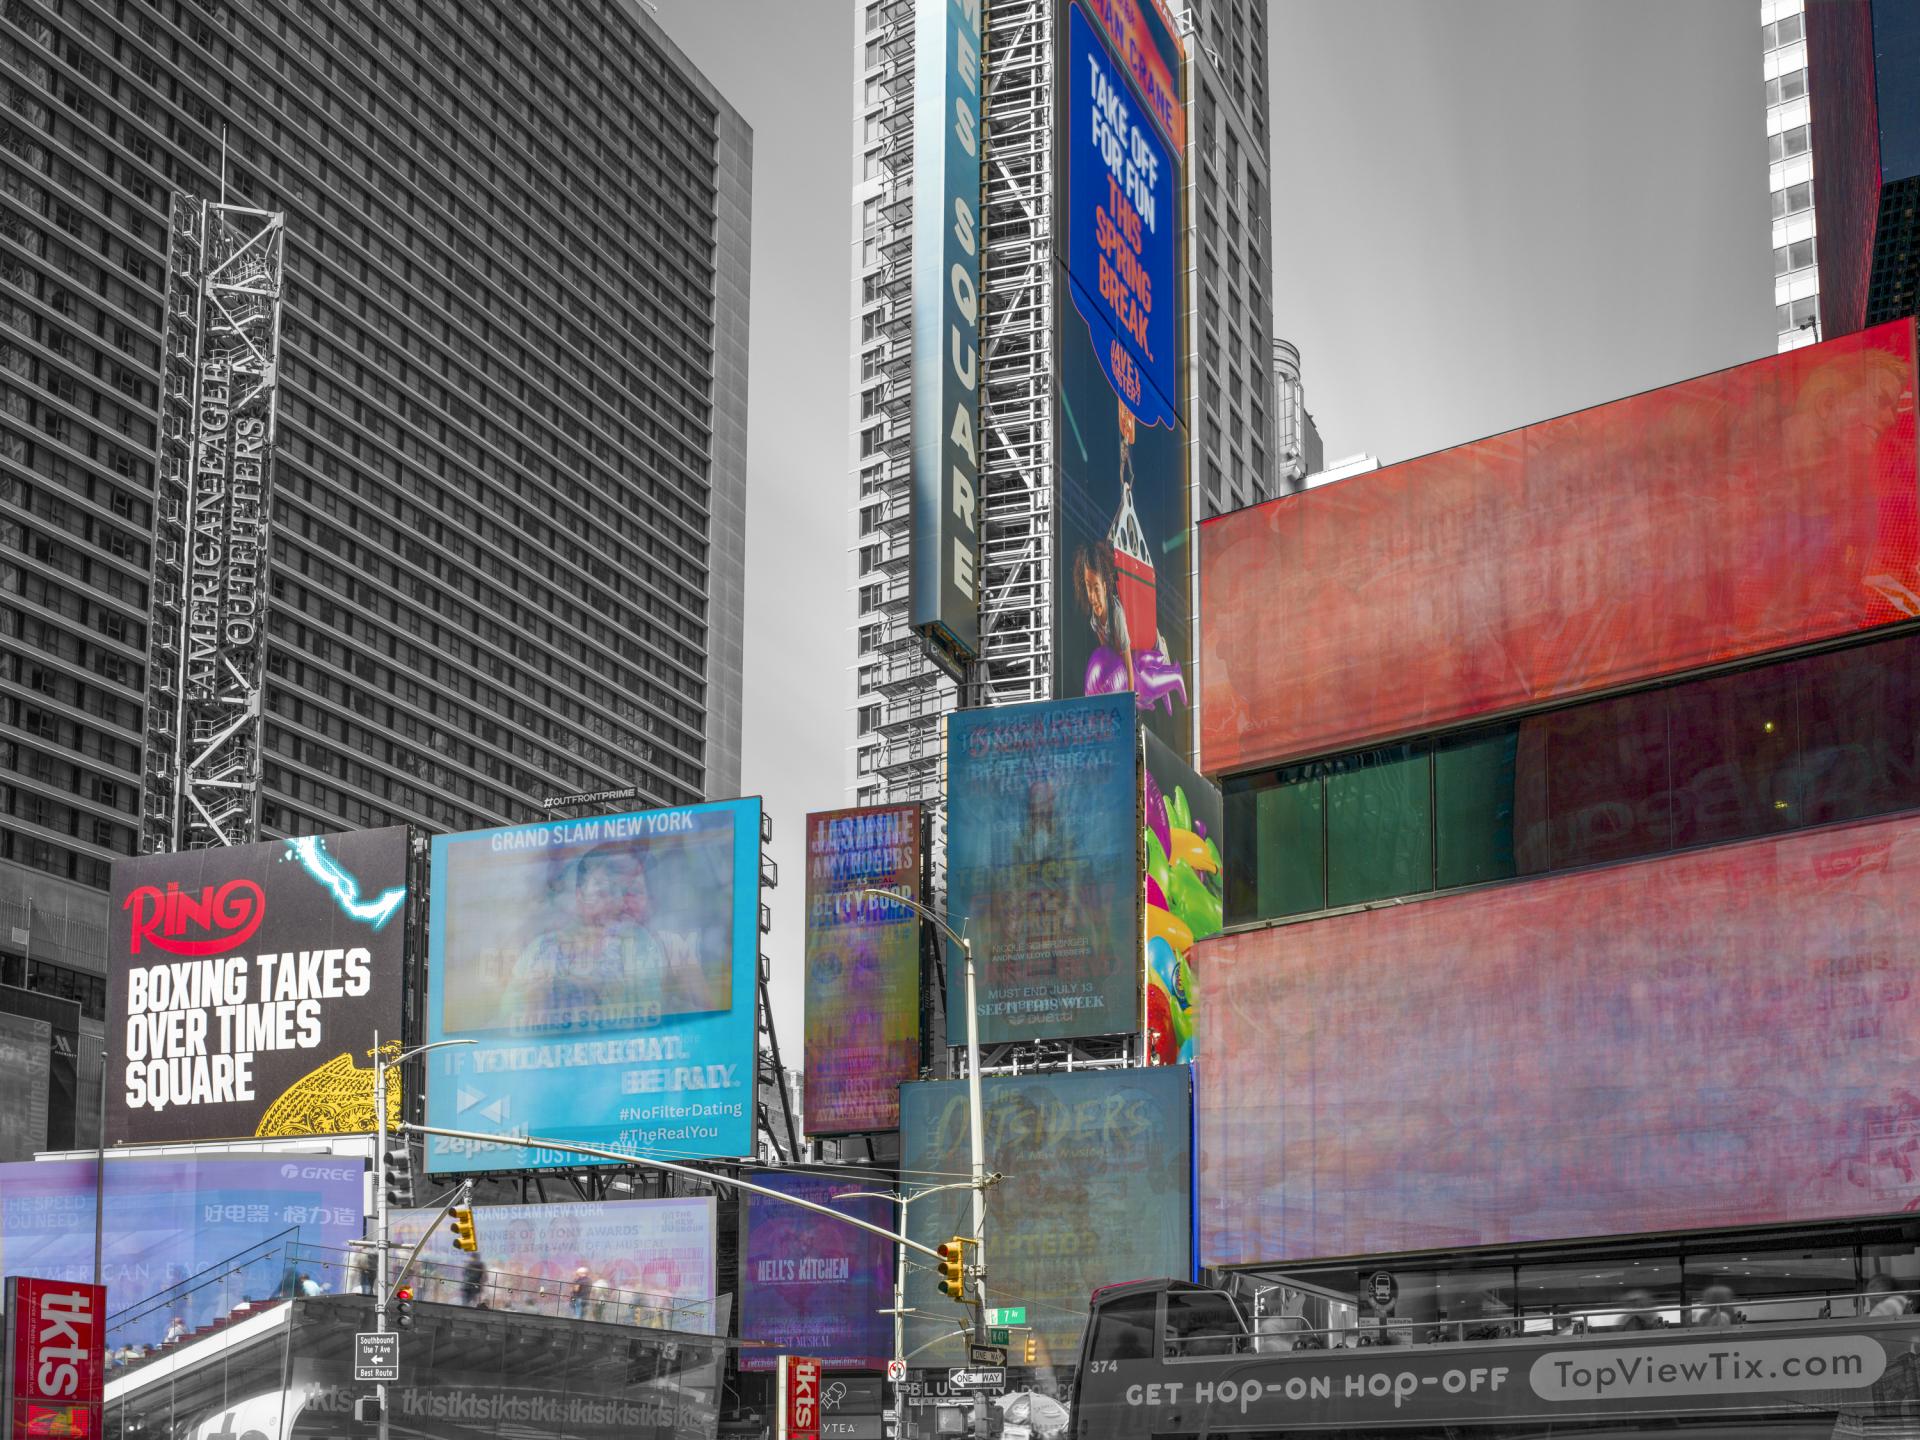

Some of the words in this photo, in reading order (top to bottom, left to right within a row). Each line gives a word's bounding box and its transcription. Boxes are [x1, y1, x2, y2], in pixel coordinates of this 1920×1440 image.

[1088, 53, 1129, 150] TAKE
[1131, 126, 1158, 190] OFF
[1092, 105, 1122, 185] FOR
[1126, 157, 1156, 234] FUN
[1107, 174, 1141, 255] THIS
[1096, 205, 1151, 313] SPRING
[951, 197, 978, 601] SQUARE
[225, 416, 264, 645] OUTFITTERS
[187, 484, 226, 691] AMERICAN
[543, 788, 636, 809] #OUTFRONTPRIME
[492, 828, 549, 852] GRAND
[553, 823, 599, 844] SLAM
[603, 815, 645, 840] NEW
[647, 809, 693, 833] YORK
[167, 881, 179, 891] THE
[122, 879, 266, 956] RING
[128, 957, 248, 1015] BOXING
[256, 948, 371, 1002] TAKES
[988, 987, 1021, 1000] MUST
[1024, 985, 1048, 997] END
[1051, 984, 1077, 996] JULY
[1063, 995, 1105, 1009] WEEK
[126, 1007, 208, 1062] OVER
[215, 999, 321, 1054] TIMES
[125, 1052, 255, 1112] SQUARE
[619, 1102, 743, 1125] #NoFilterDating
[619, 1126, 718, 1145] #TheRealYou
[302, 1167, 356, 1181] GREE
[205, 1204, 356, 1226] 好电器·格力造
[512, 1205, 543, 1219] SLAM
[544, 1205, 568, 1219] NEW
[570, 1204, 605, 1218] YORK
[758, 1259, 795, 1281] HELL'S
[799, 1257, 849, 1280] KITCHEN
[1004, 1310, 1009, 1322] 7
[38, 1290, 92, 1396] tkts
[380, 1345, 390, 1353] Ave
[975, 1351, 987, 1360] ONE
[1090, 1360, 1118, 1374] 374
[375, 1369, 393, 1377] Route
[956, 1374, 974, 1382] ONE
[982, 1373, 1000, 1382] WAY
[1554, 1352, 1863, 1394] TopViewTix.com
[796, 1362, 817, 1428] tkts
[1126, 1383, 1183, 1406] GET
